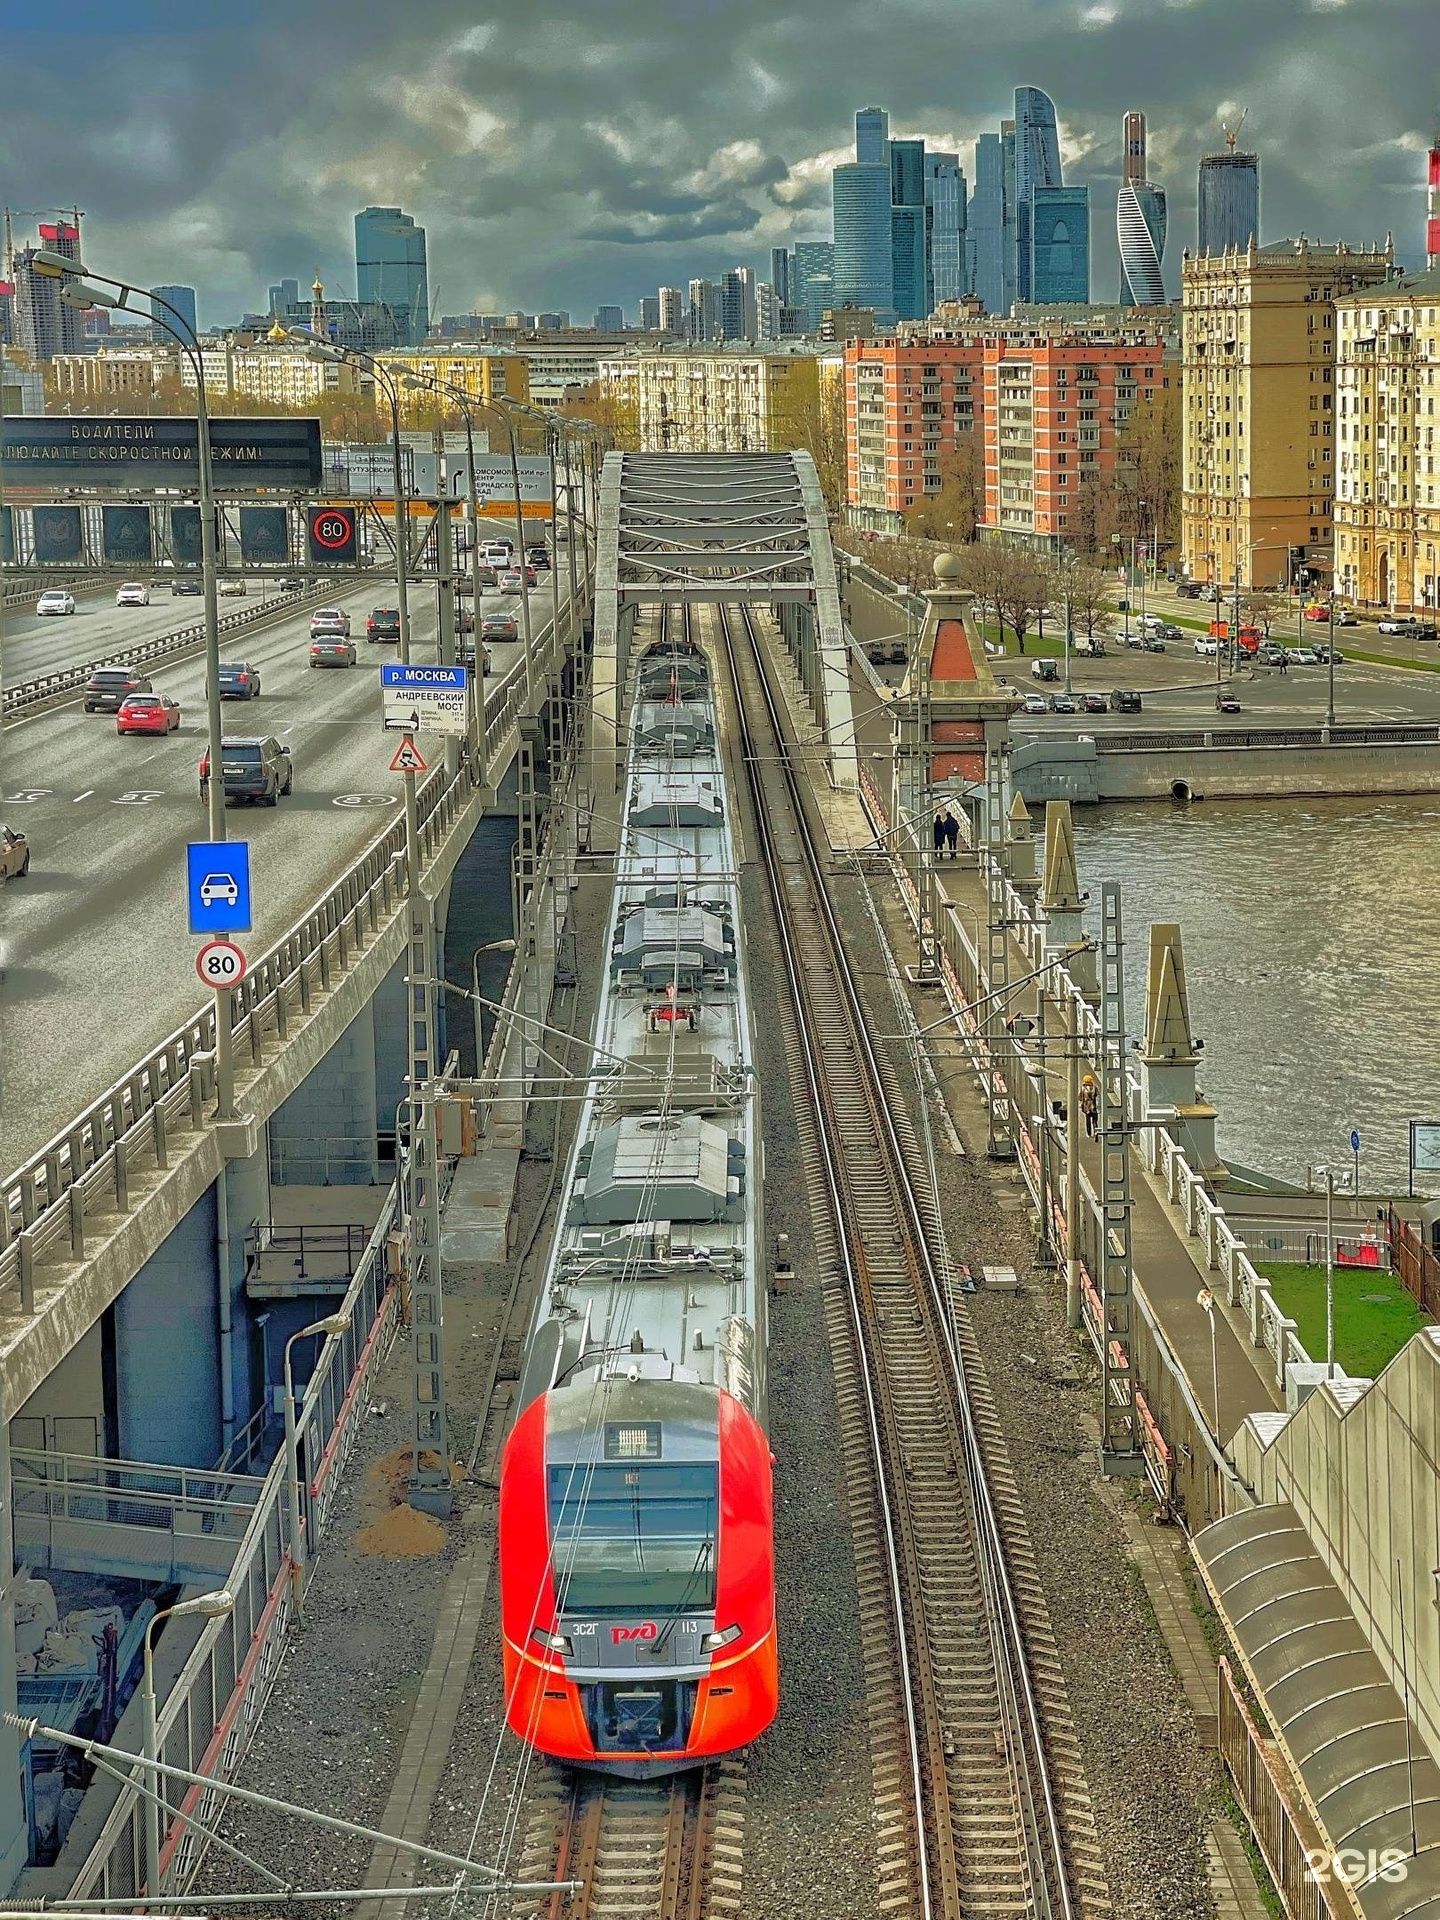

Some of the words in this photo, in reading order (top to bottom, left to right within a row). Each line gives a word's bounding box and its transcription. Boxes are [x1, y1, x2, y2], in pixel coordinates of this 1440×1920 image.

[71, 425, 154, 439] ВОДИТЕЛИ
[88, 446, 192, 460] СКОРОСТНОЙ
[211, 446, 263, 460] ЕЖИМ!
[322, 522, 343, 537] 80
[391, 671, 402, 682] р.
[405, 670, 456, 682] МОСКВА
[395, 691, 464, 702] АНДРЕЕВСКИЙ
[437, 702, 464, 711] МОСТ
[208, 956, 235, 975] 80
[572, 1623, 599, 1636] ЭС2Г
[611, 1621, 658, 1645] РЖД
[682, 1621, 698, 1633] 113
